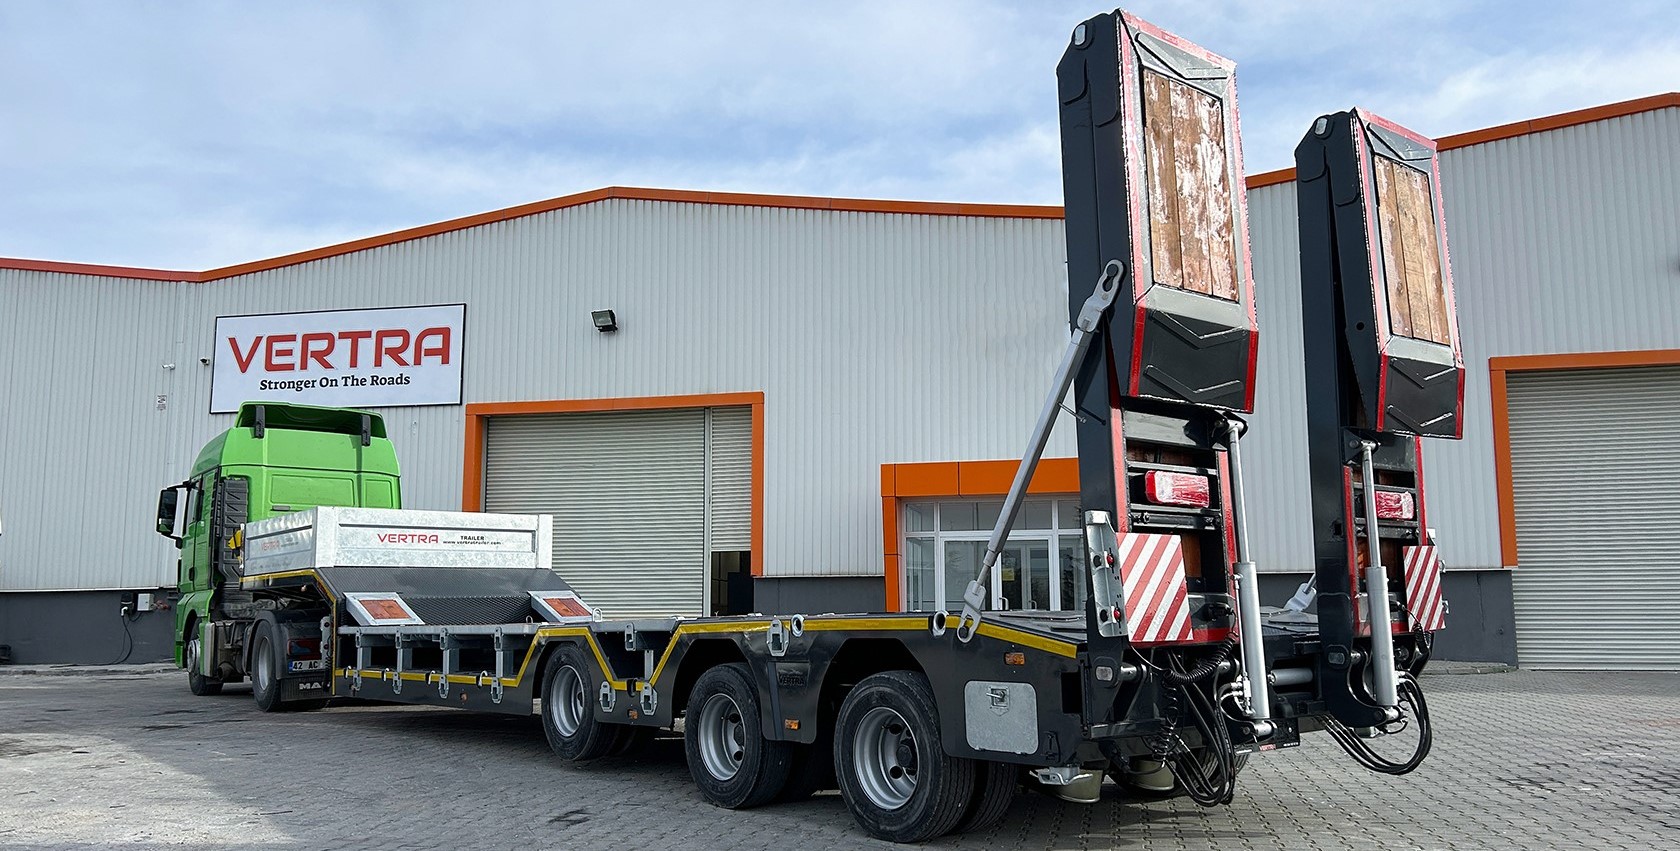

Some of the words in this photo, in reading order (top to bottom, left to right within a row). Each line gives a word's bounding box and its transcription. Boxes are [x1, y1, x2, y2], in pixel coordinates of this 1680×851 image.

[228, 326, 450, 374] VERTRA
[260, 378, 317, 391] Stronger
[319, 376, 339, 388] On
[341, 375, 367, 387] The
[370, 373, 411, 386] Roads
[377, 533, 439, 544] VERTRA
[293, 662, 303, 670] 42
